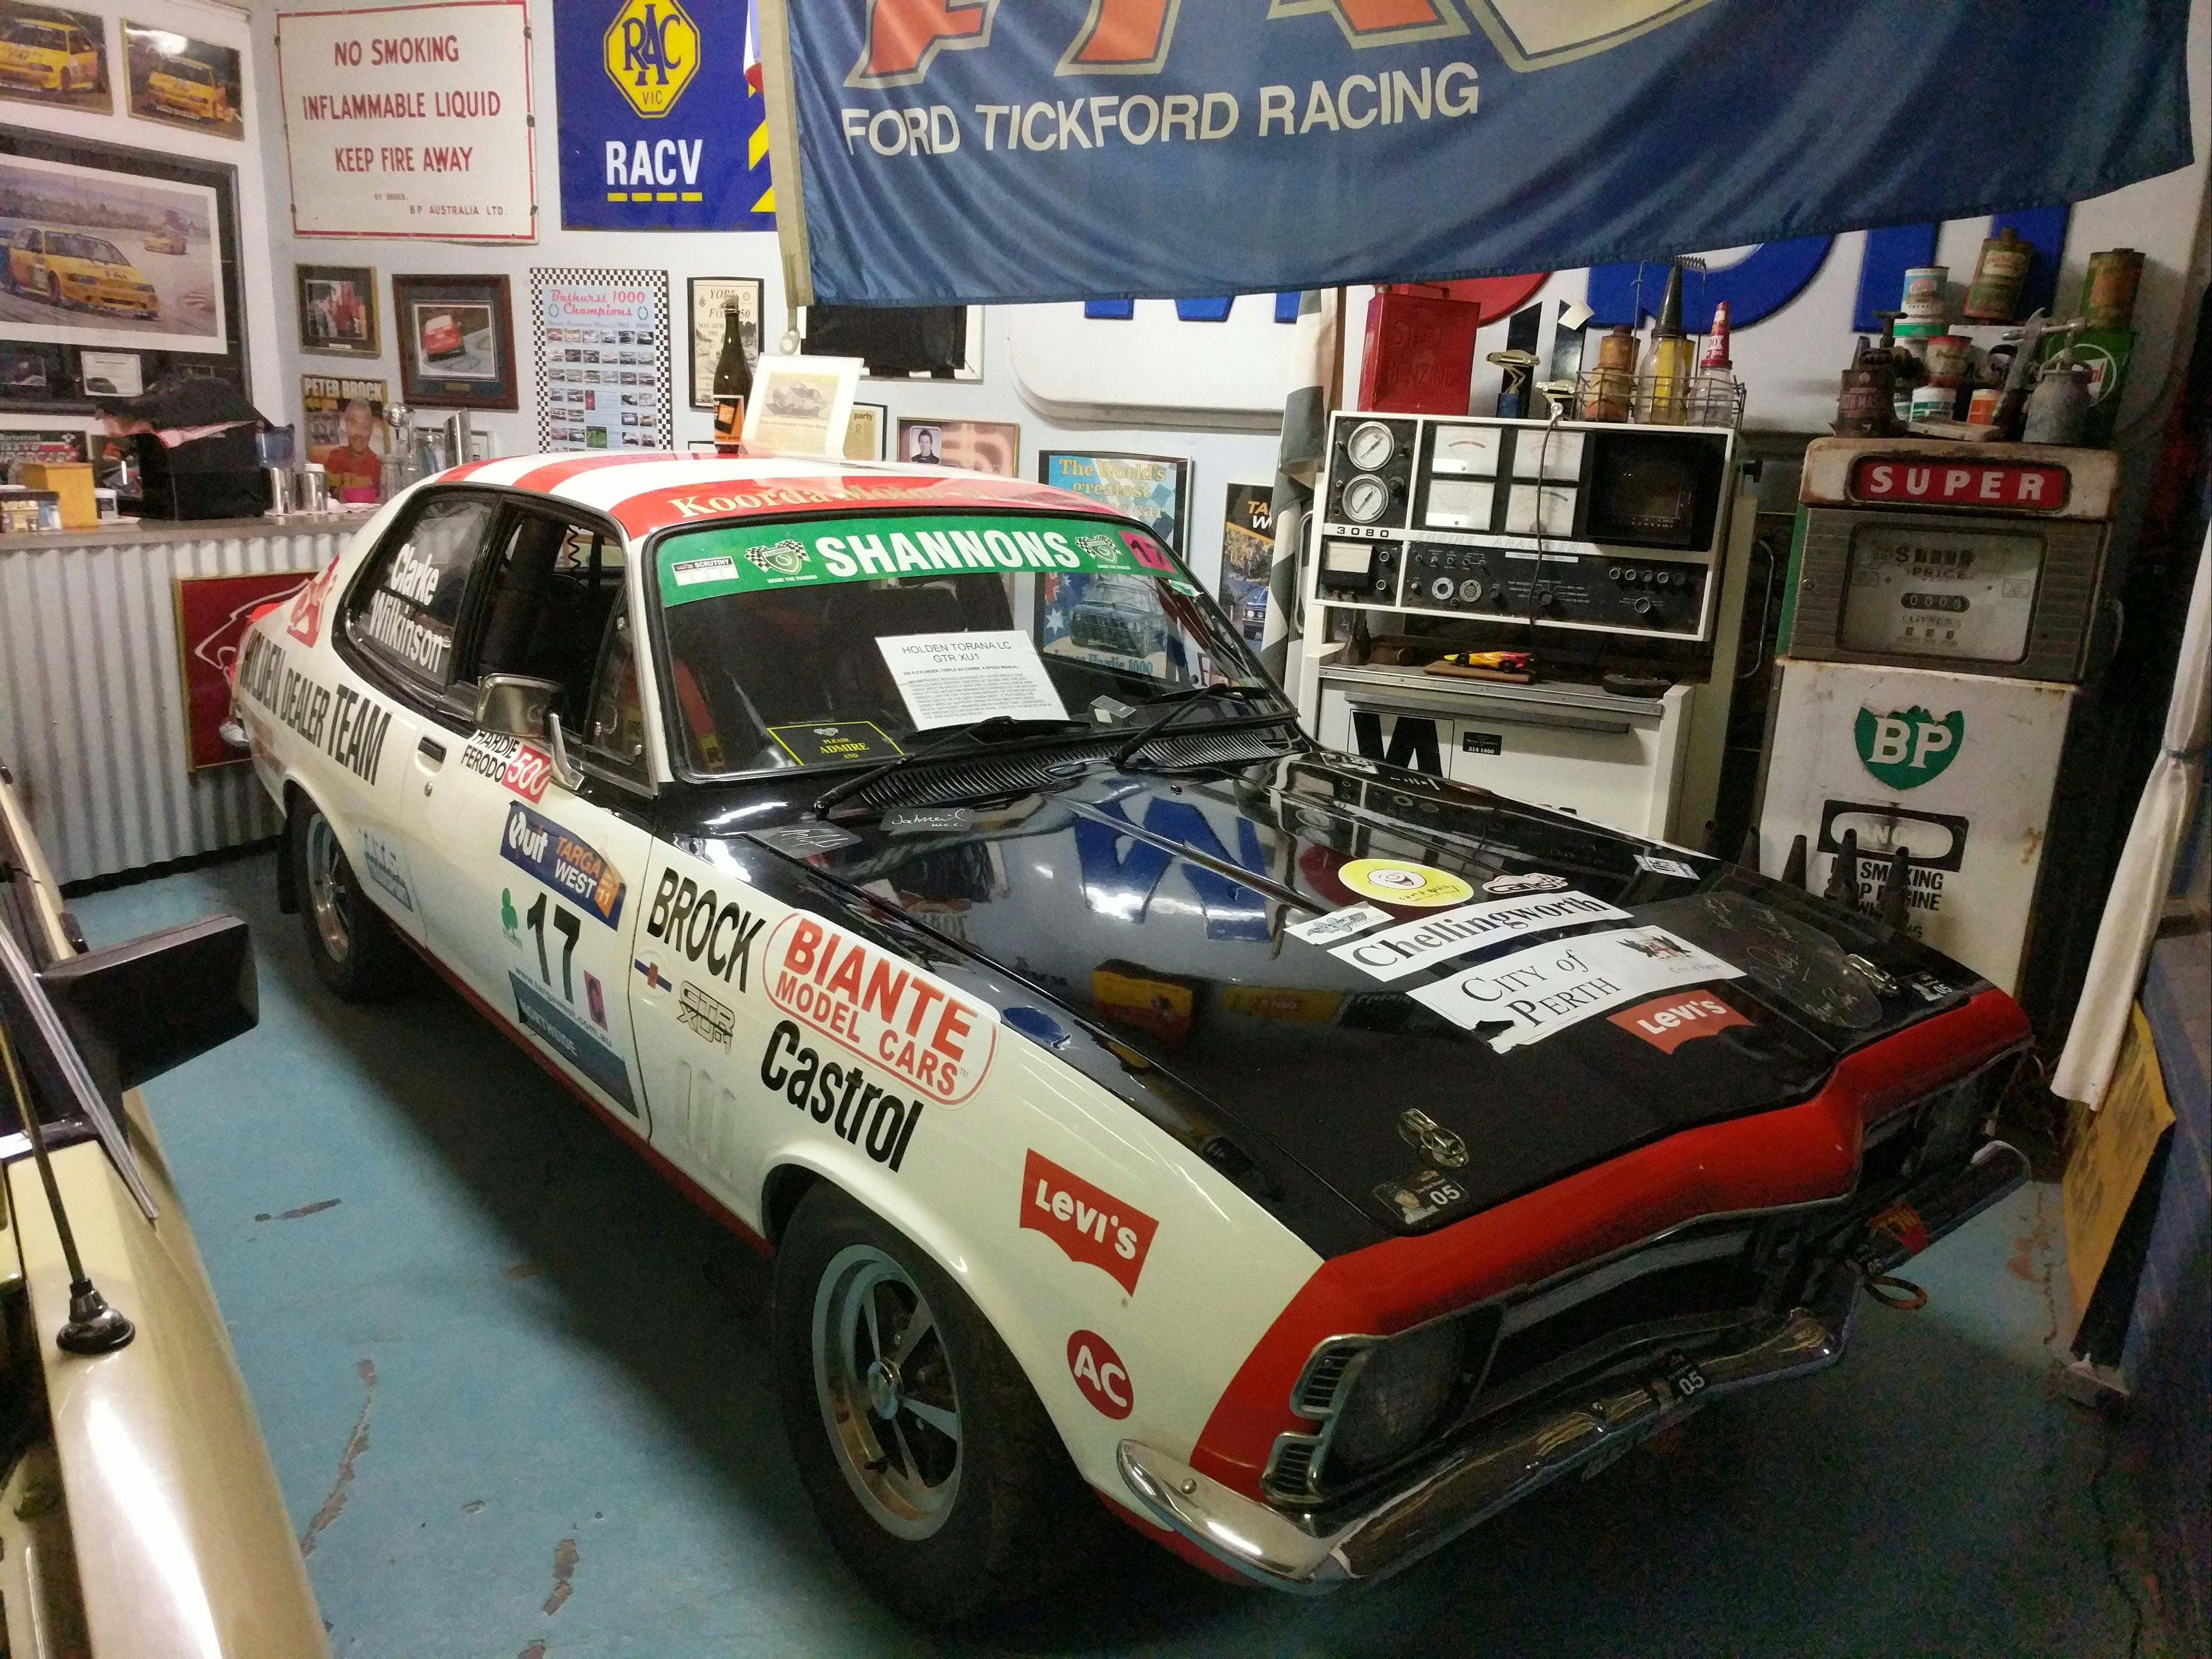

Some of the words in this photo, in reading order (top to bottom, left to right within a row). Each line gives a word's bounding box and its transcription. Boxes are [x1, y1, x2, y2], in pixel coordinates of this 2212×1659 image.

[334, 40, 362, 66] NO
[371, 35, 459, 66] SMOKING
[302, 92, 426, 120] INFLAMMABLE
[435, 90, 501, 119] LIQUID
[642, 90, 662, 105] VIC
[842, 104, 962, 157] FORD
[975, 91, 1239, 151] TICKFORD
[1258, 61, 1480, 138] RACING
[334, 147, 374, 172] KEEP
[381, 147, 415, 172] FIRE
[423, 146, 474, 172] AWAY
[605, 139, 703, 185] RACV
[410, 205, 423, 214] BP
[429, 205, 479, 215] AUSTRALIA
[551, 289, 606, 302] Bathurst
[613, 290, 645, 303] 1000
[563, 302, 632, 316] Champions
[854, 413, 873, 421] party
[1059, 459, 1093, 476] The
[1097, 461, 1166, 482] World's
[1868, 464, 2045, 502] SUPER
[666, 481, 834, 520] Koorda
[1073, 482, 1151, 498] greatest
[1133, 505, 1166, 518] car
[1337, 526, 1389, 538] 3080
[1416, 533, 1476, 545] ENGINE
[694, 559, 729, 569] SCRUTINY
[816, 529, 1081, 578] SHANNONS
[1130, 539, 1165, 566] 17
[390, 543, 440, 606] Clarke
[369, 589, 443, 673] Wilkinson
[901, 643, 949, 654] HOLDEN
[949, 642, 997, 652] TORANA
[997, 641, 1012, 650] LC
[933, 654, 956, 663] GTR
[959, 653, 980, 661] XU1
[280, 667, 331, 748] DEALER
[327, 683, 393, 786] TEAM
[1867, 716, 1954, 769] BP
[461, 744, 507, 783] FERODO
[819, 743, 870, 754] ADMIRE
[556, 836, 601, 878] TARGA
[555, 859, 598, 898] WEST
[1860, 861, 1944, 890] SMING
[646, 867, 767, 993] BROCK
[1351, 893, 1611, 970] Chellingworth
[527, 891, 581, 1005] 17
[1556, 949, 1590, 974] of
[782, 917, 979, 1062] BIANTE
[1503, 976, 1623, 1029] PERTH
[1933, 984, 1954, 995] 05
[680, 980, 735, 1035] GTR
[1636, 996, 1729, 1036] Levi's
[775, 973, 861, 1043] MODEL
[879, 1028, 960, 1097] CARS
[760, 1019, 924, 1174] Castrol
[1429, 1184, 1460, 1205] 05
[1035, 1178, 1138, 1260] Levi's
[1073, 1344, 1128, 1408] AC
[1679, 1370, 1705, 1395] 05
